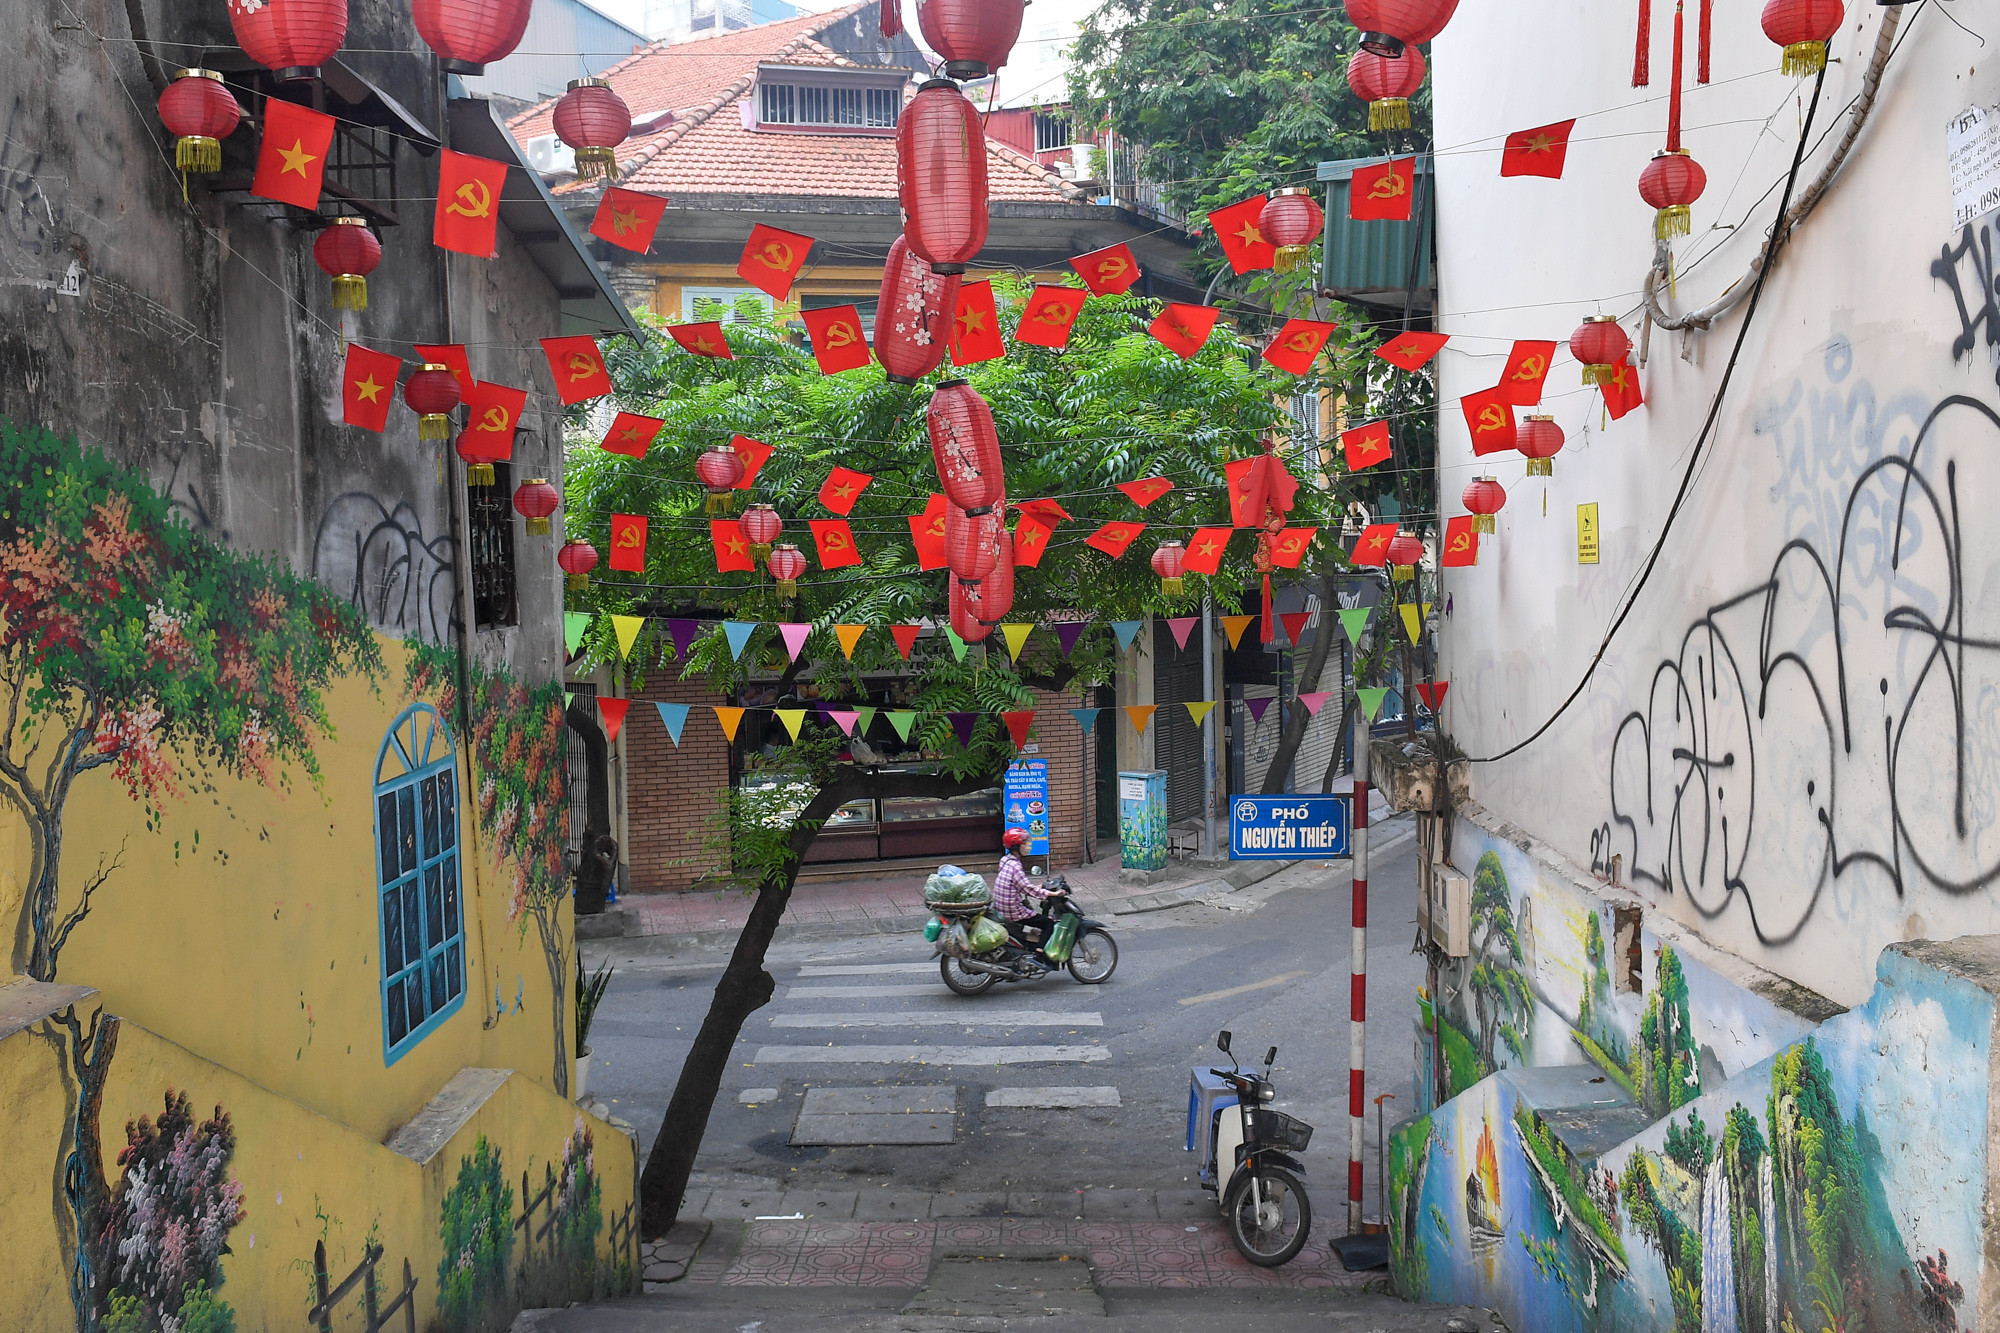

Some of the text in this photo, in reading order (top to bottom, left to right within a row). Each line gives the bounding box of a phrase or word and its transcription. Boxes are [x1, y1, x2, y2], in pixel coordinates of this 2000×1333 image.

[1980, 187, 2000, 211] 098
[1271, 803, 1310, 820] PHỐ
[1242, 820, 1337, 849] NGUYỄN THIẾP
